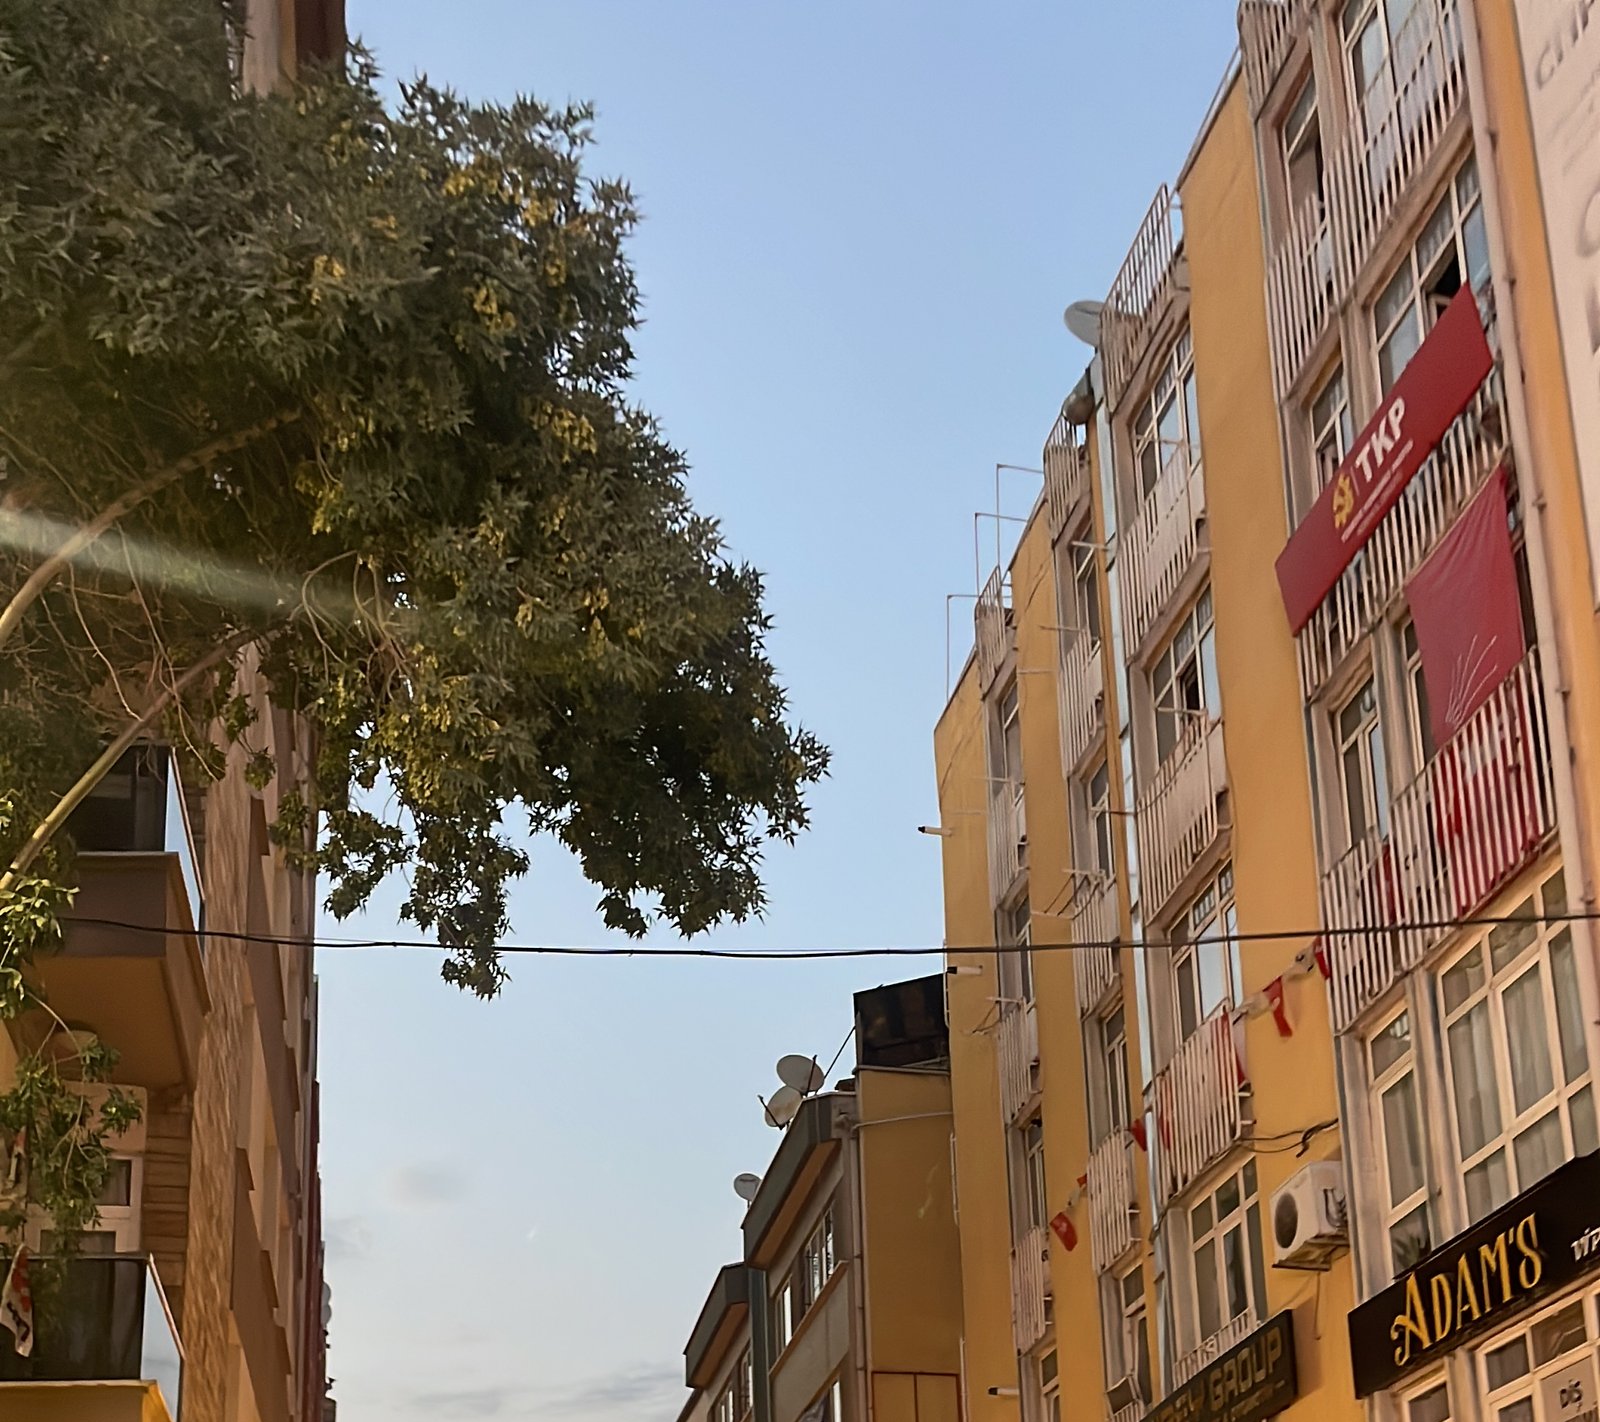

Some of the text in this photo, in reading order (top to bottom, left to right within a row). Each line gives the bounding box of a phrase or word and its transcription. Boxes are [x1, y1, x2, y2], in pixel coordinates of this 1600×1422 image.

[1355, 397, 1405, 483] TKP
[1390, 1212, 1542, 1366] ADAM'S
[1209, 1326, 1282, 1412] GROUP
